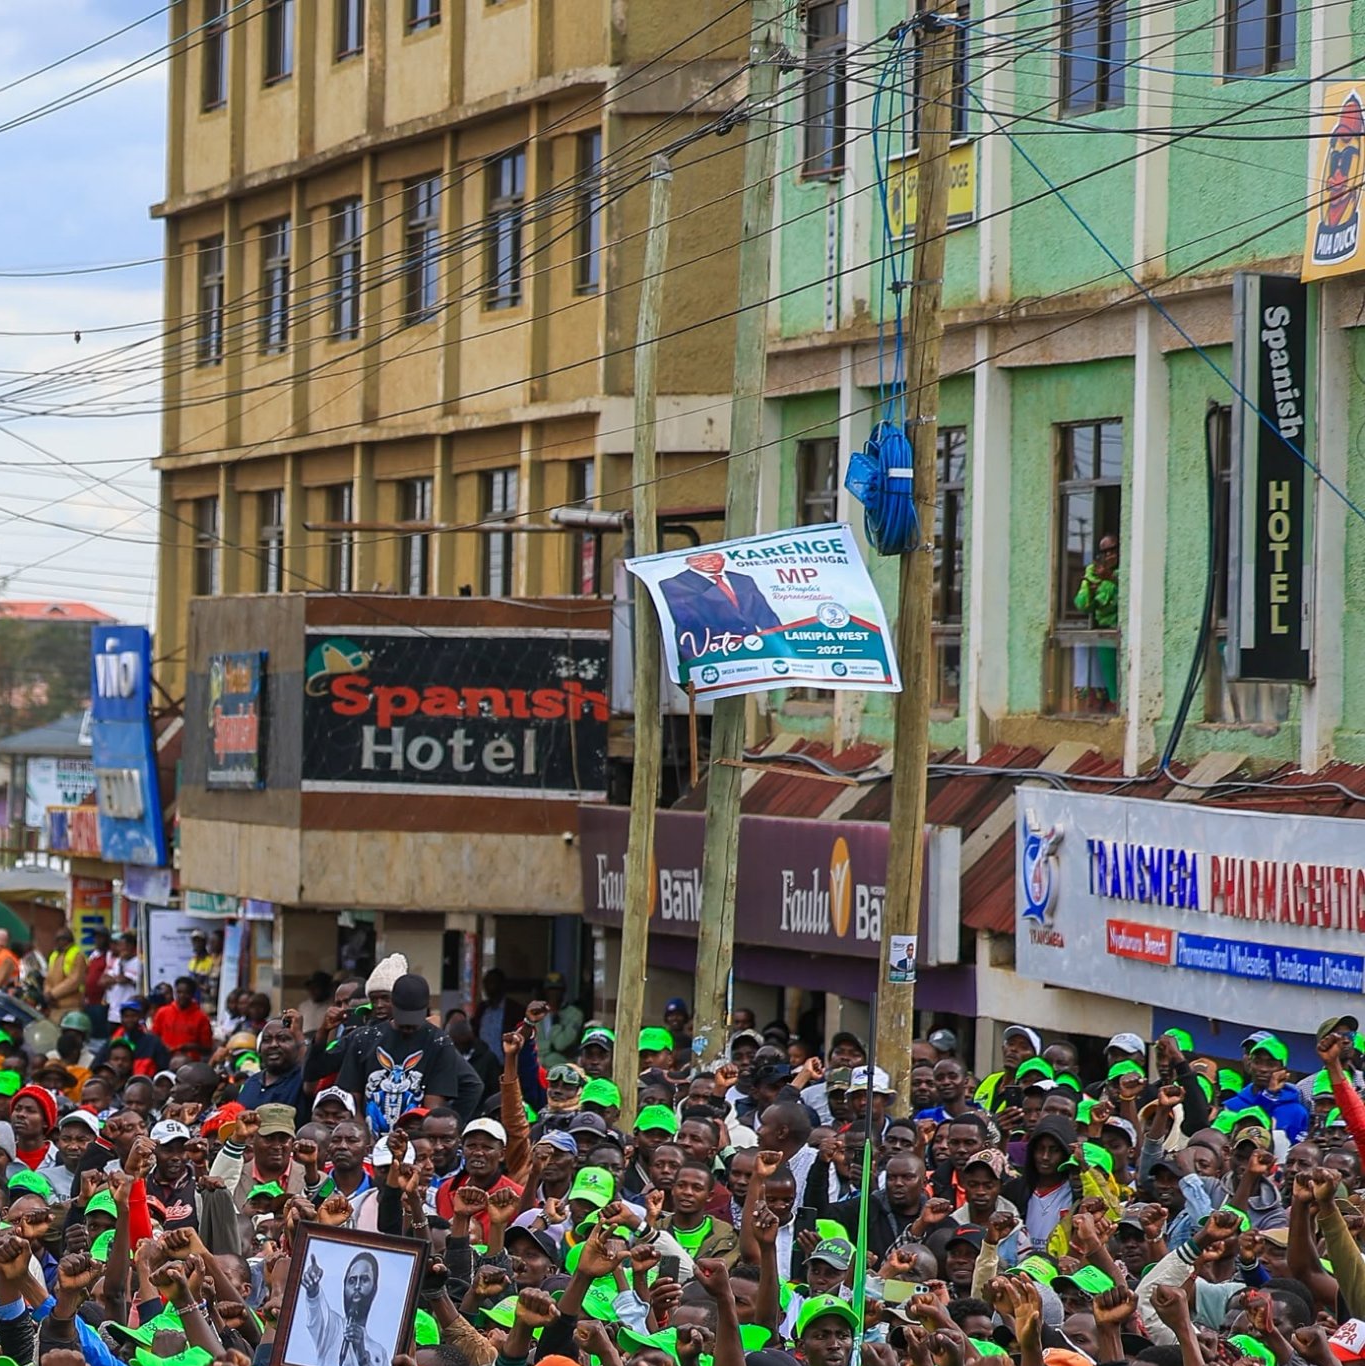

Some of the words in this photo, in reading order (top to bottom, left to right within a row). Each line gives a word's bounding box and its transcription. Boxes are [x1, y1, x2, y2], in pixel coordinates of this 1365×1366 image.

[1317, 231, 1333, 255] MIA
[1334, 223, 1357, 254] DUCK
[1263, 304, 1304, 440] Spanish
[727, 538, 847, 561] KARENGE
[735, 556, 797, 568] ONESMUS
[800, 555, 849, 566] MUNGAI
[1268, 480, 1290, 636] HOTEL
[775, 567, 819, 584] MP
[680, 628, 744, 658] Vote
[784, 631, 835, 641] LAIKIPIA
[836, 631, 869, 641] WEST
[816, 645, 844, 654] 2027
[330, 675, 609, 728] Spanish
[361, 725, 537, 775] Hotel
[1086, 838, 1200, 912] TRANSMEGA
[780, 868, 830, 936] Faulu
[1029, 929, 1065, 948] TRANSMEGA
[1144, 931, 1167, 956] Branch
[1275, 950, 1308, 981] Retailers
[1310, 957, 1324, 984] and
